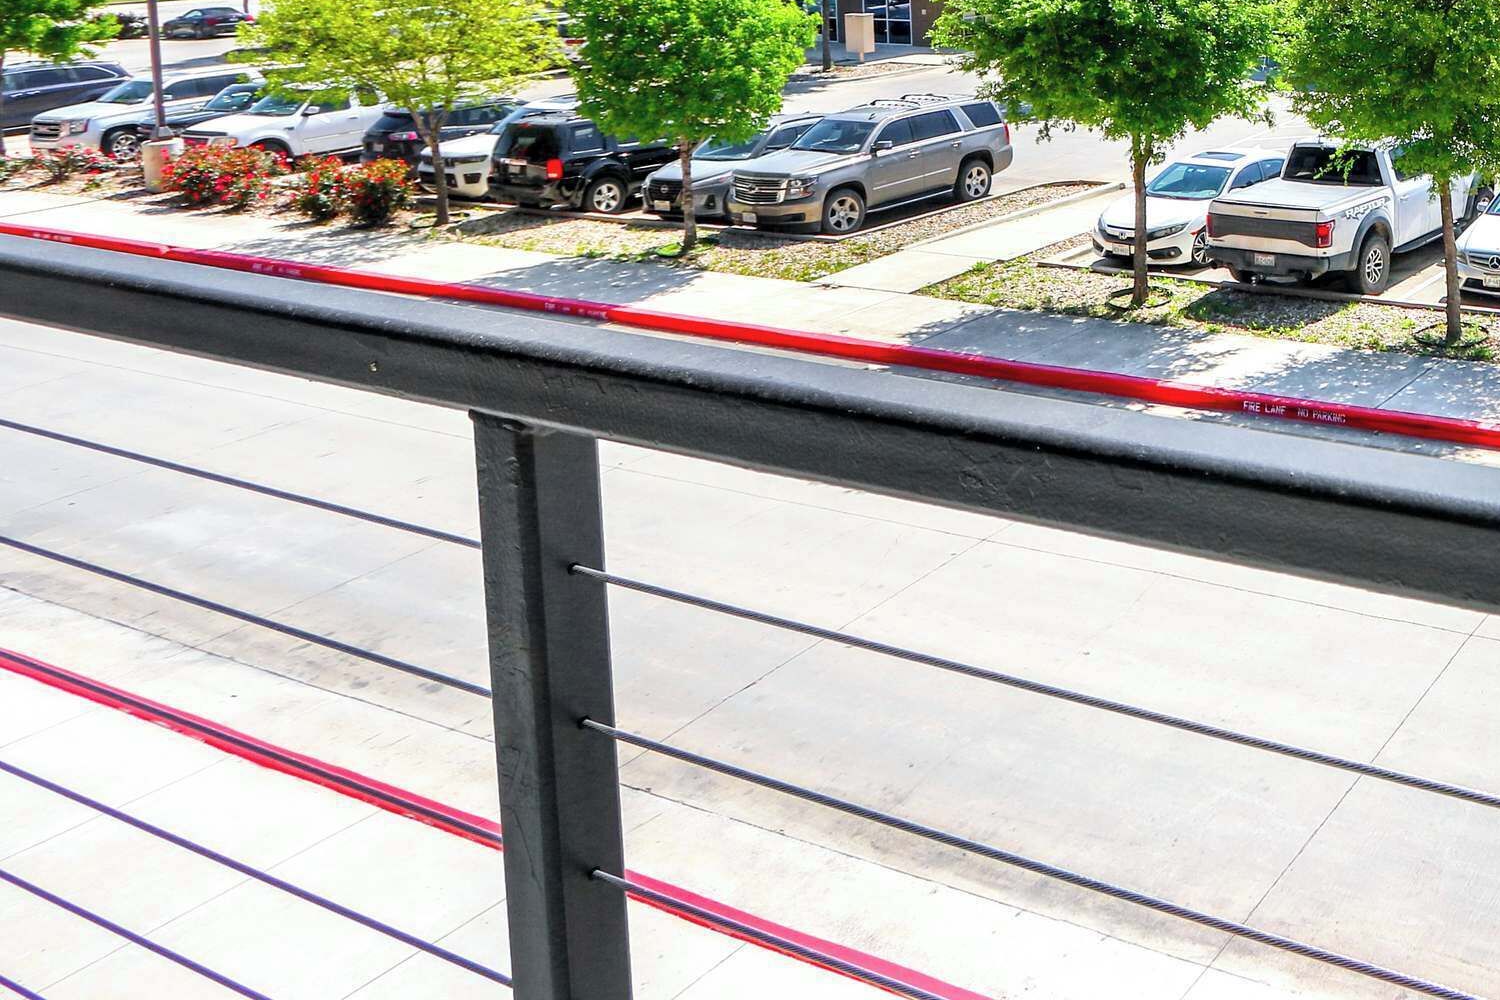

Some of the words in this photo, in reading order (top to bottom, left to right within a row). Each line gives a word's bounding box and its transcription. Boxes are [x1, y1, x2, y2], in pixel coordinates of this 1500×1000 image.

[1345, 198, 1388, 220] RAPTOR
[1243, 401, 1261, 412] FIRE
[1264, 404, 1287, 415] LANE
[1297, 407, 1309, 418] NO
[1312, 409, 1346, 423] PARKING
